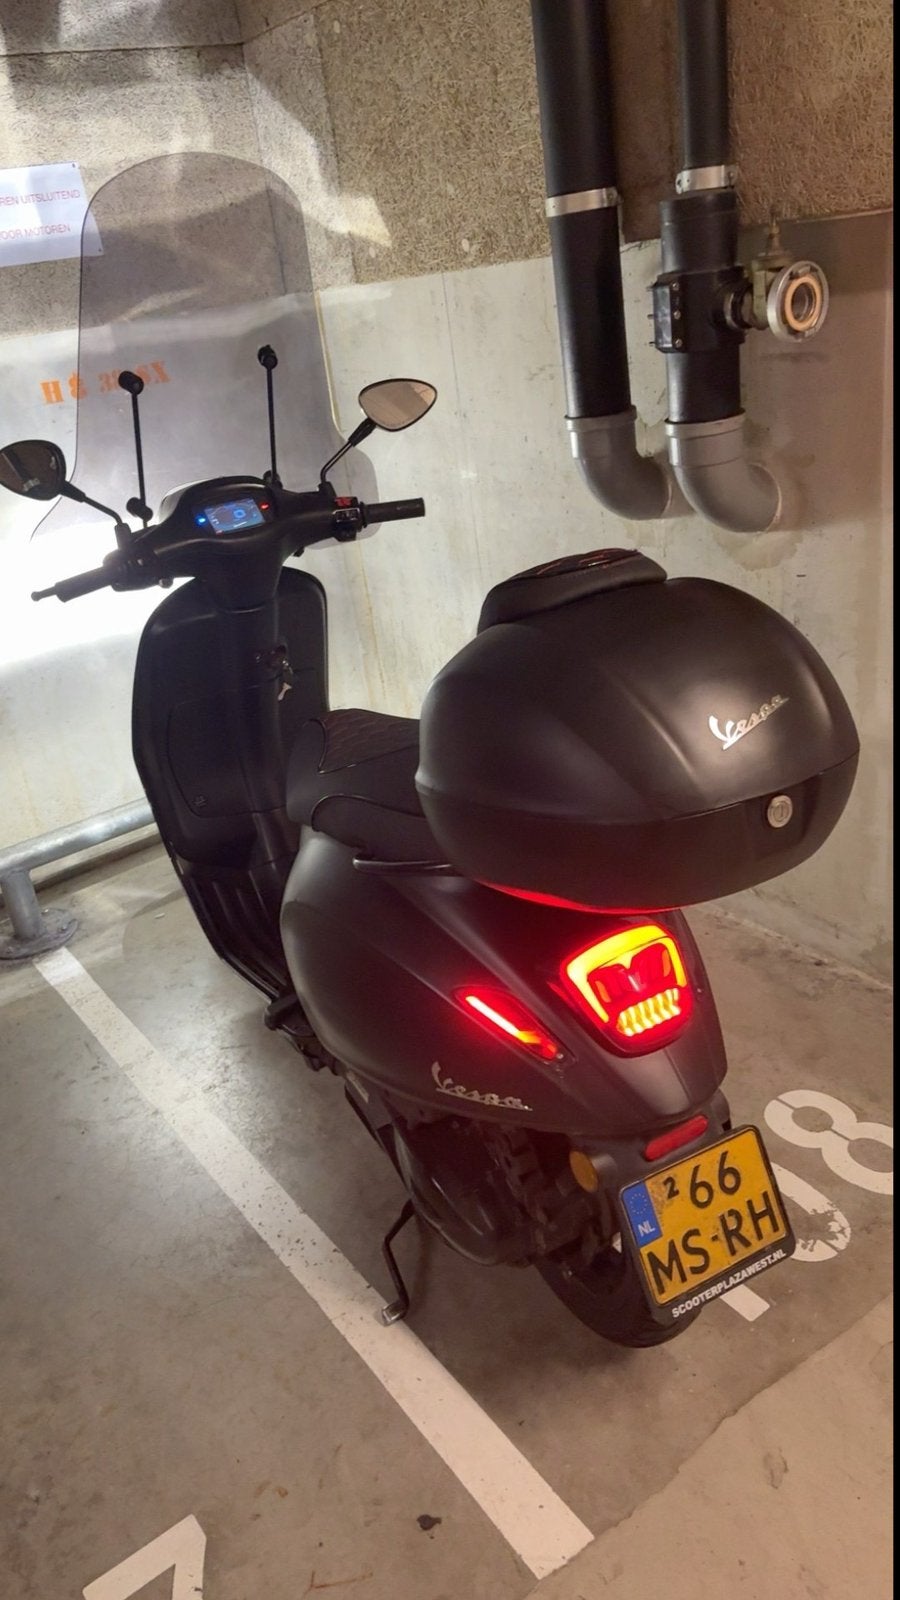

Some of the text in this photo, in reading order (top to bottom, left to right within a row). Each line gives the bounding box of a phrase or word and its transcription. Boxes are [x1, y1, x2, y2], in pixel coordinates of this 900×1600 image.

[21, 188, 81, 205] UITSLUITEND
[0, 223, 71, 240] OOR MOTOREN
[708, 694, 790, 751] Vespa
[431, 1061, 533, 1111] Vespa
[637, 1220, 656, 1237] NL
[671, 1248, 787, 1318] SCOOTERPLAZAWEST.NL
